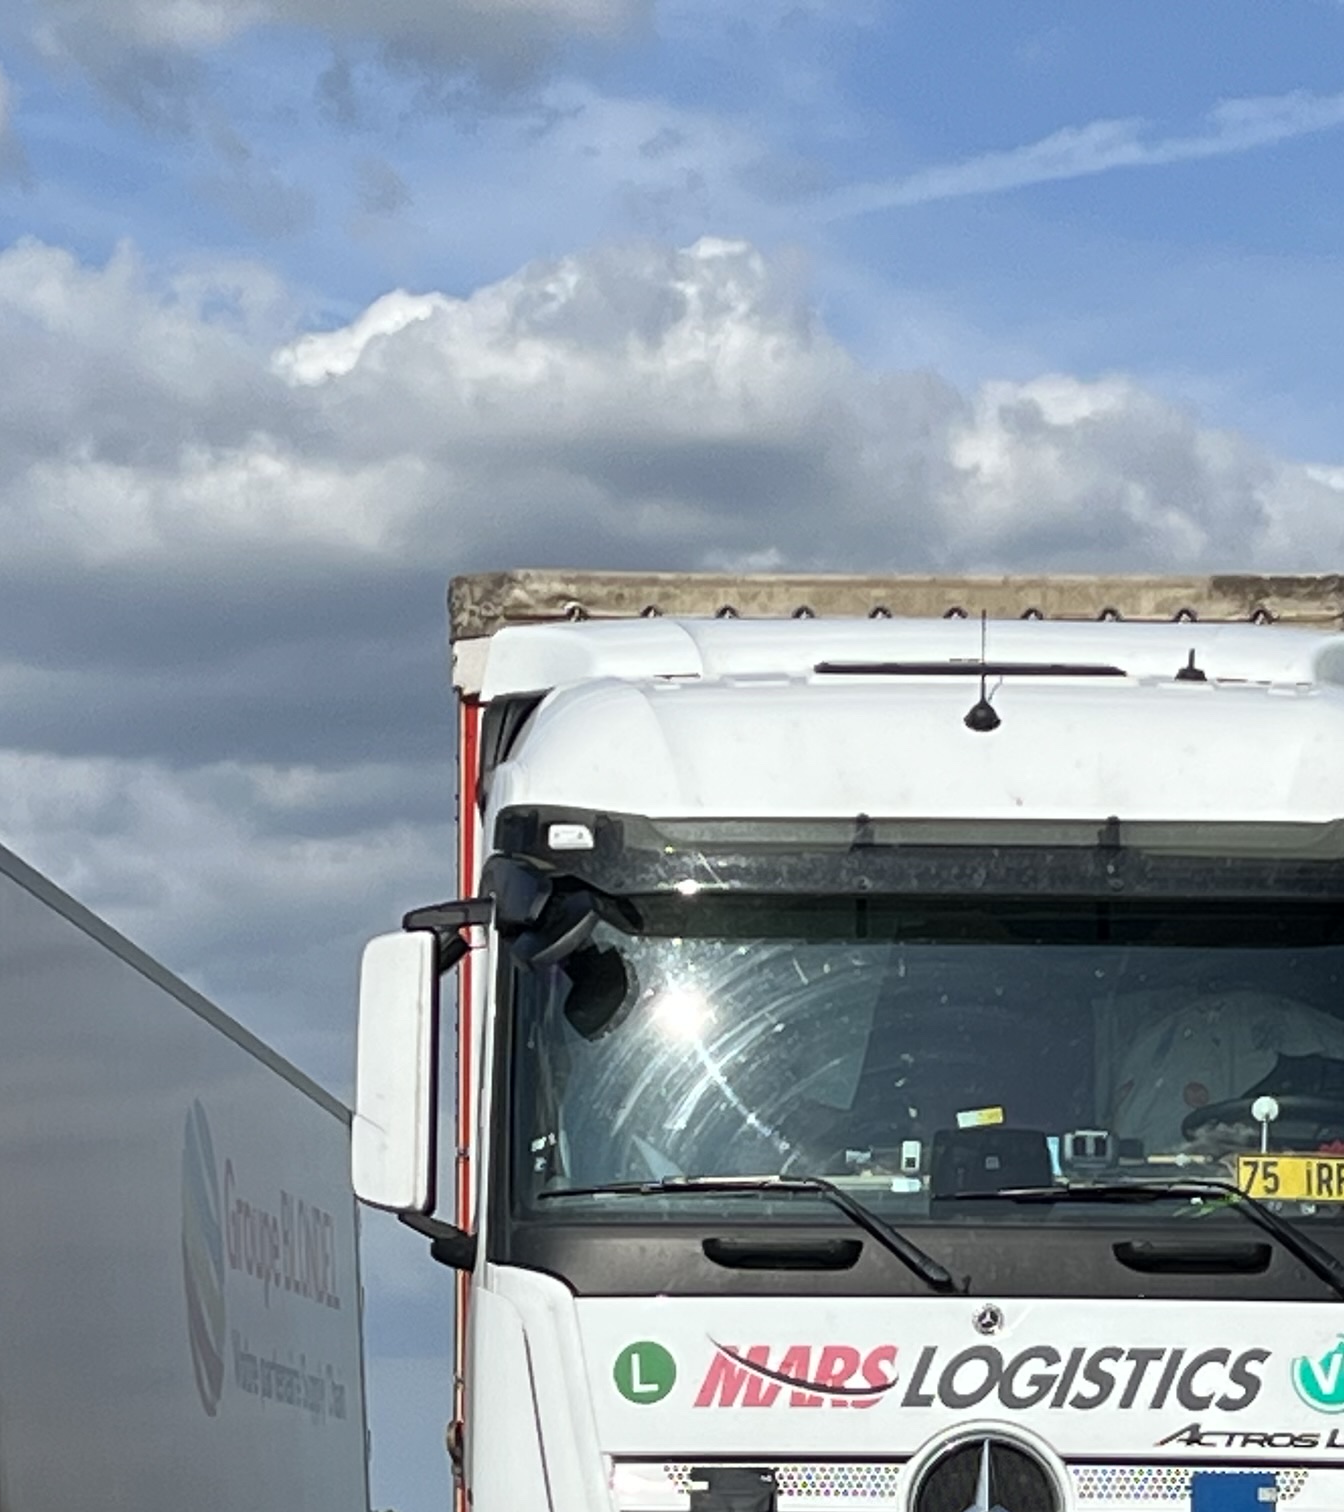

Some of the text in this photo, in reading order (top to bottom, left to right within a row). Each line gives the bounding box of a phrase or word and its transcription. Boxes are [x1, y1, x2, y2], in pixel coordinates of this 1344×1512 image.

[1243, 1161, 1280, 1194] 75
[225, 1157, 280, 1310] Groupe
[692, 1345, 1273, 1412] MARS LOGISTICS
